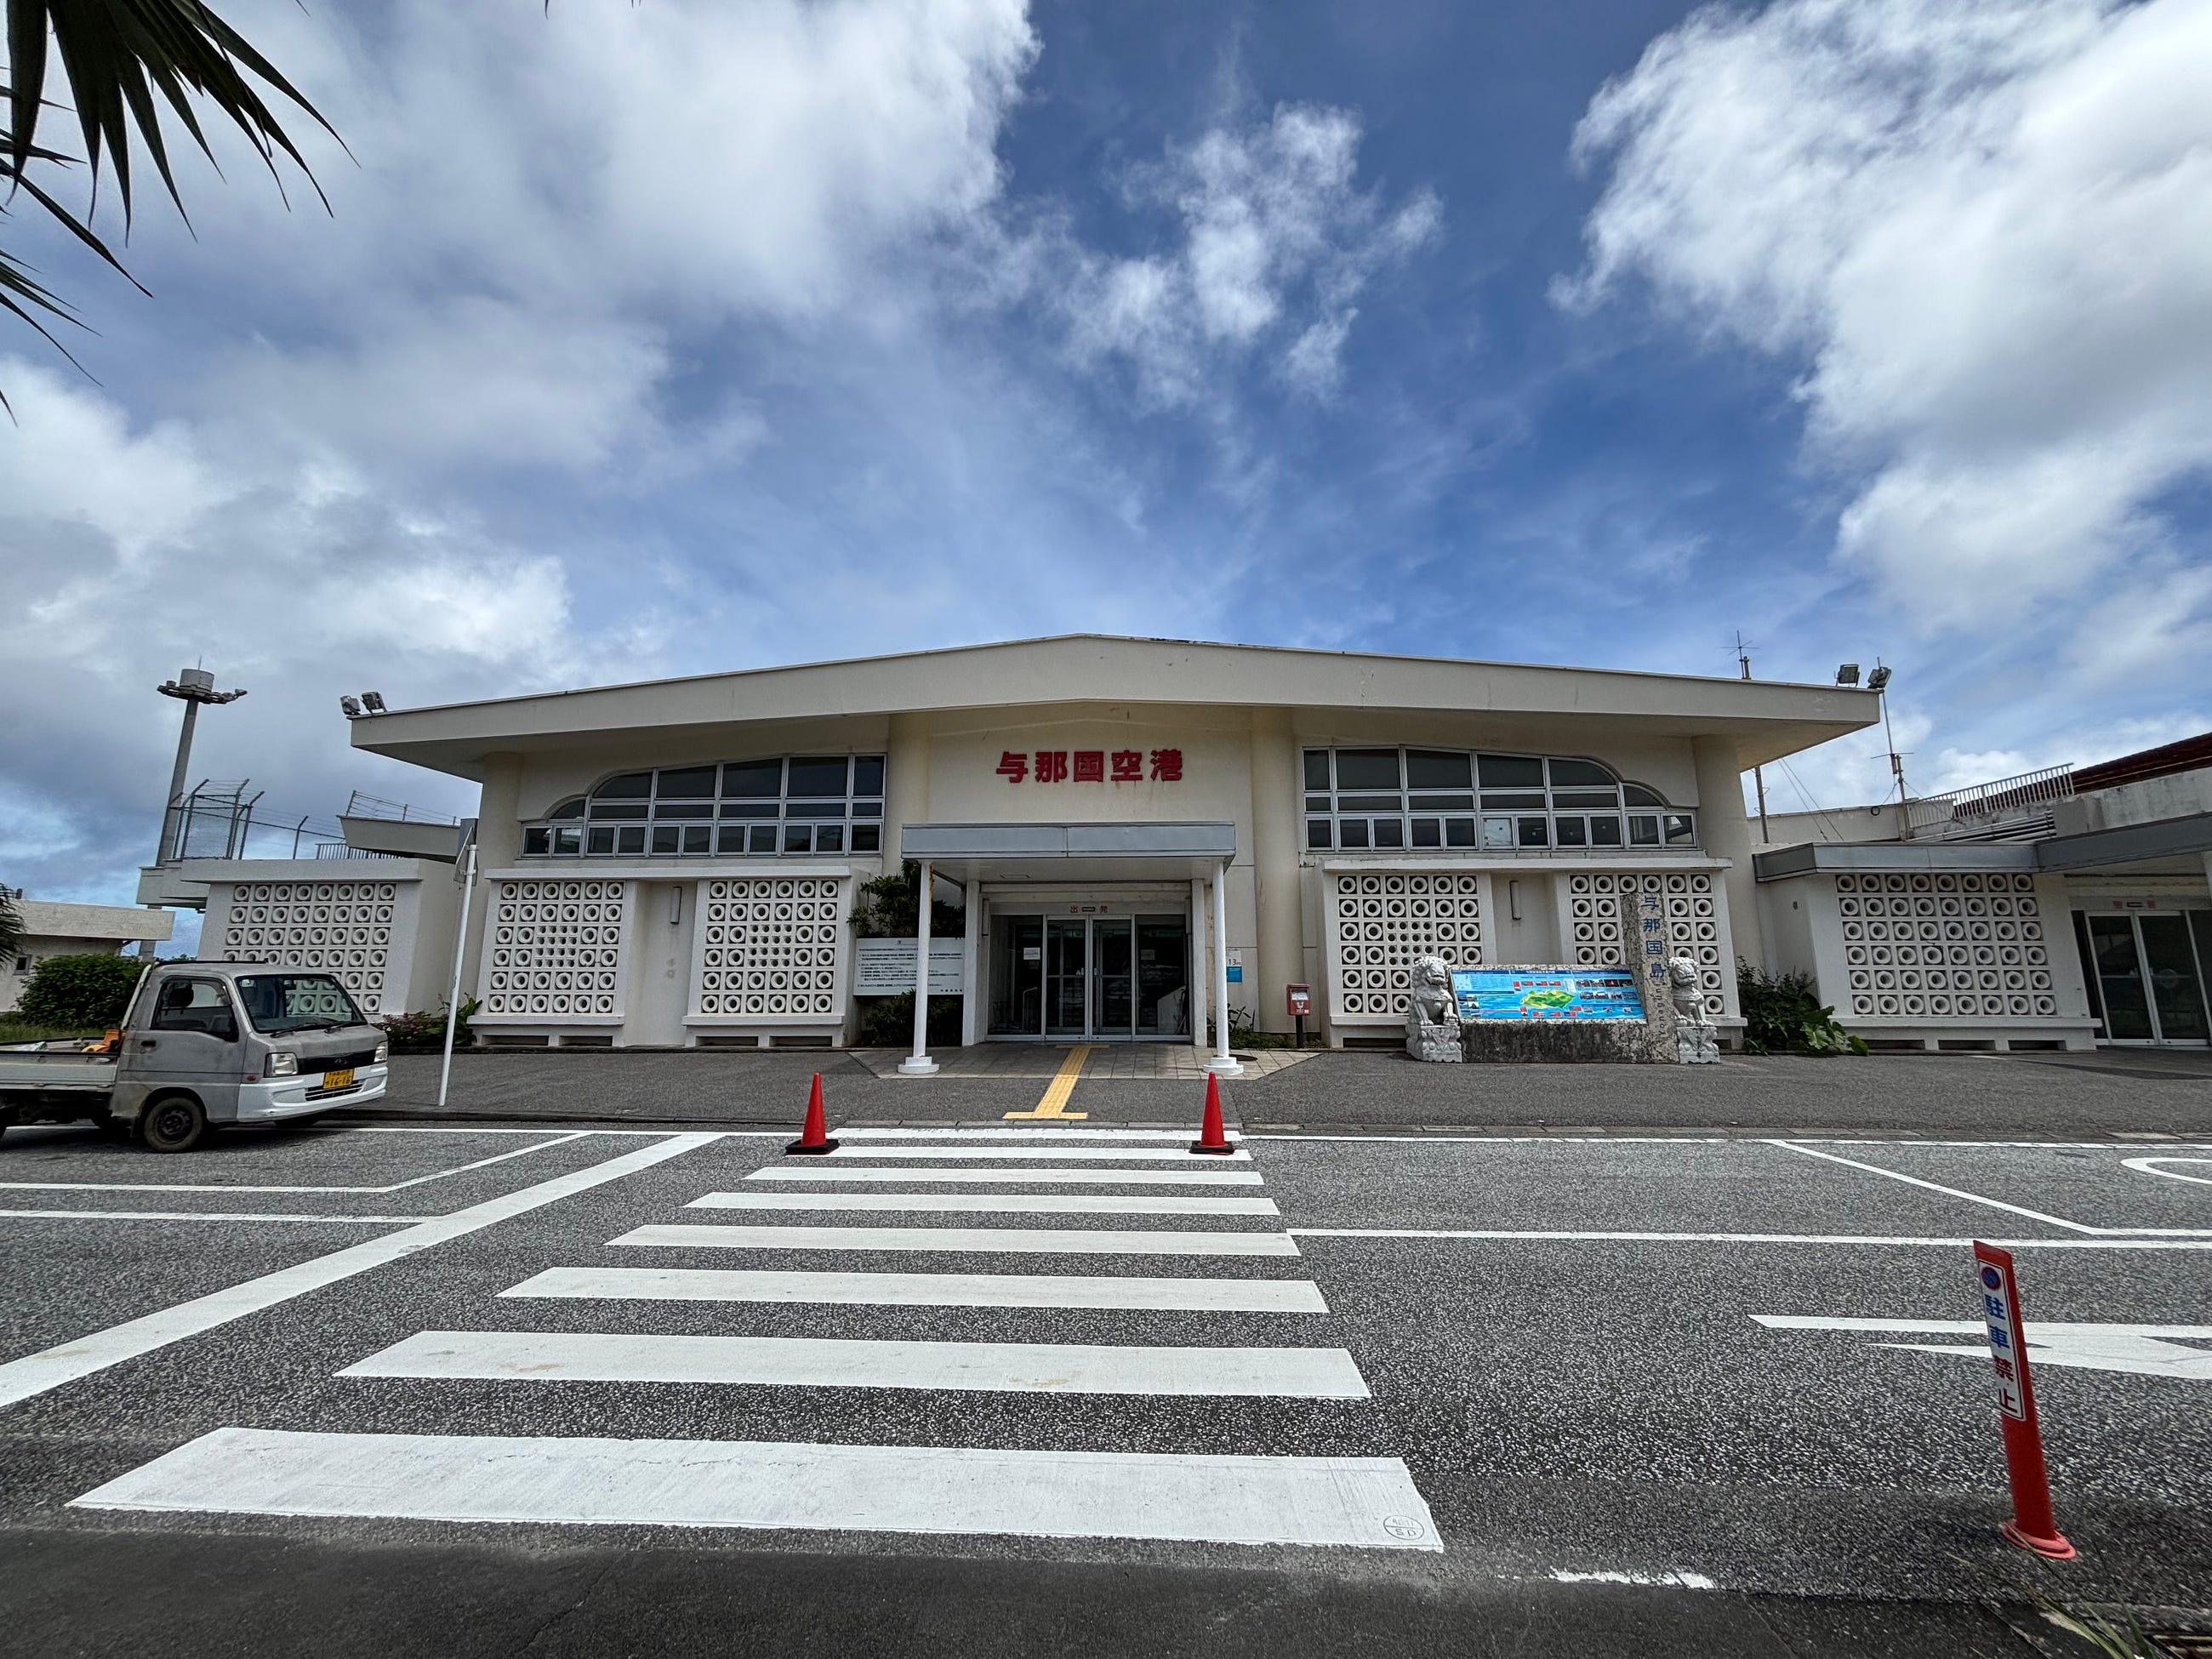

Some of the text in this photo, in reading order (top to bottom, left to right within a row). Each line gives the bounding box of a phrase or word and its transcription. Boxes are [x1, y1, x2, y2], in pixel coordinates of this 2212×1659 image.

[995, 749, 1183, 783] 与那国空港
[1641, 895, 1666, 978] 与那国島
[1984, 1293, 2018, 1413] 駐車禁止
